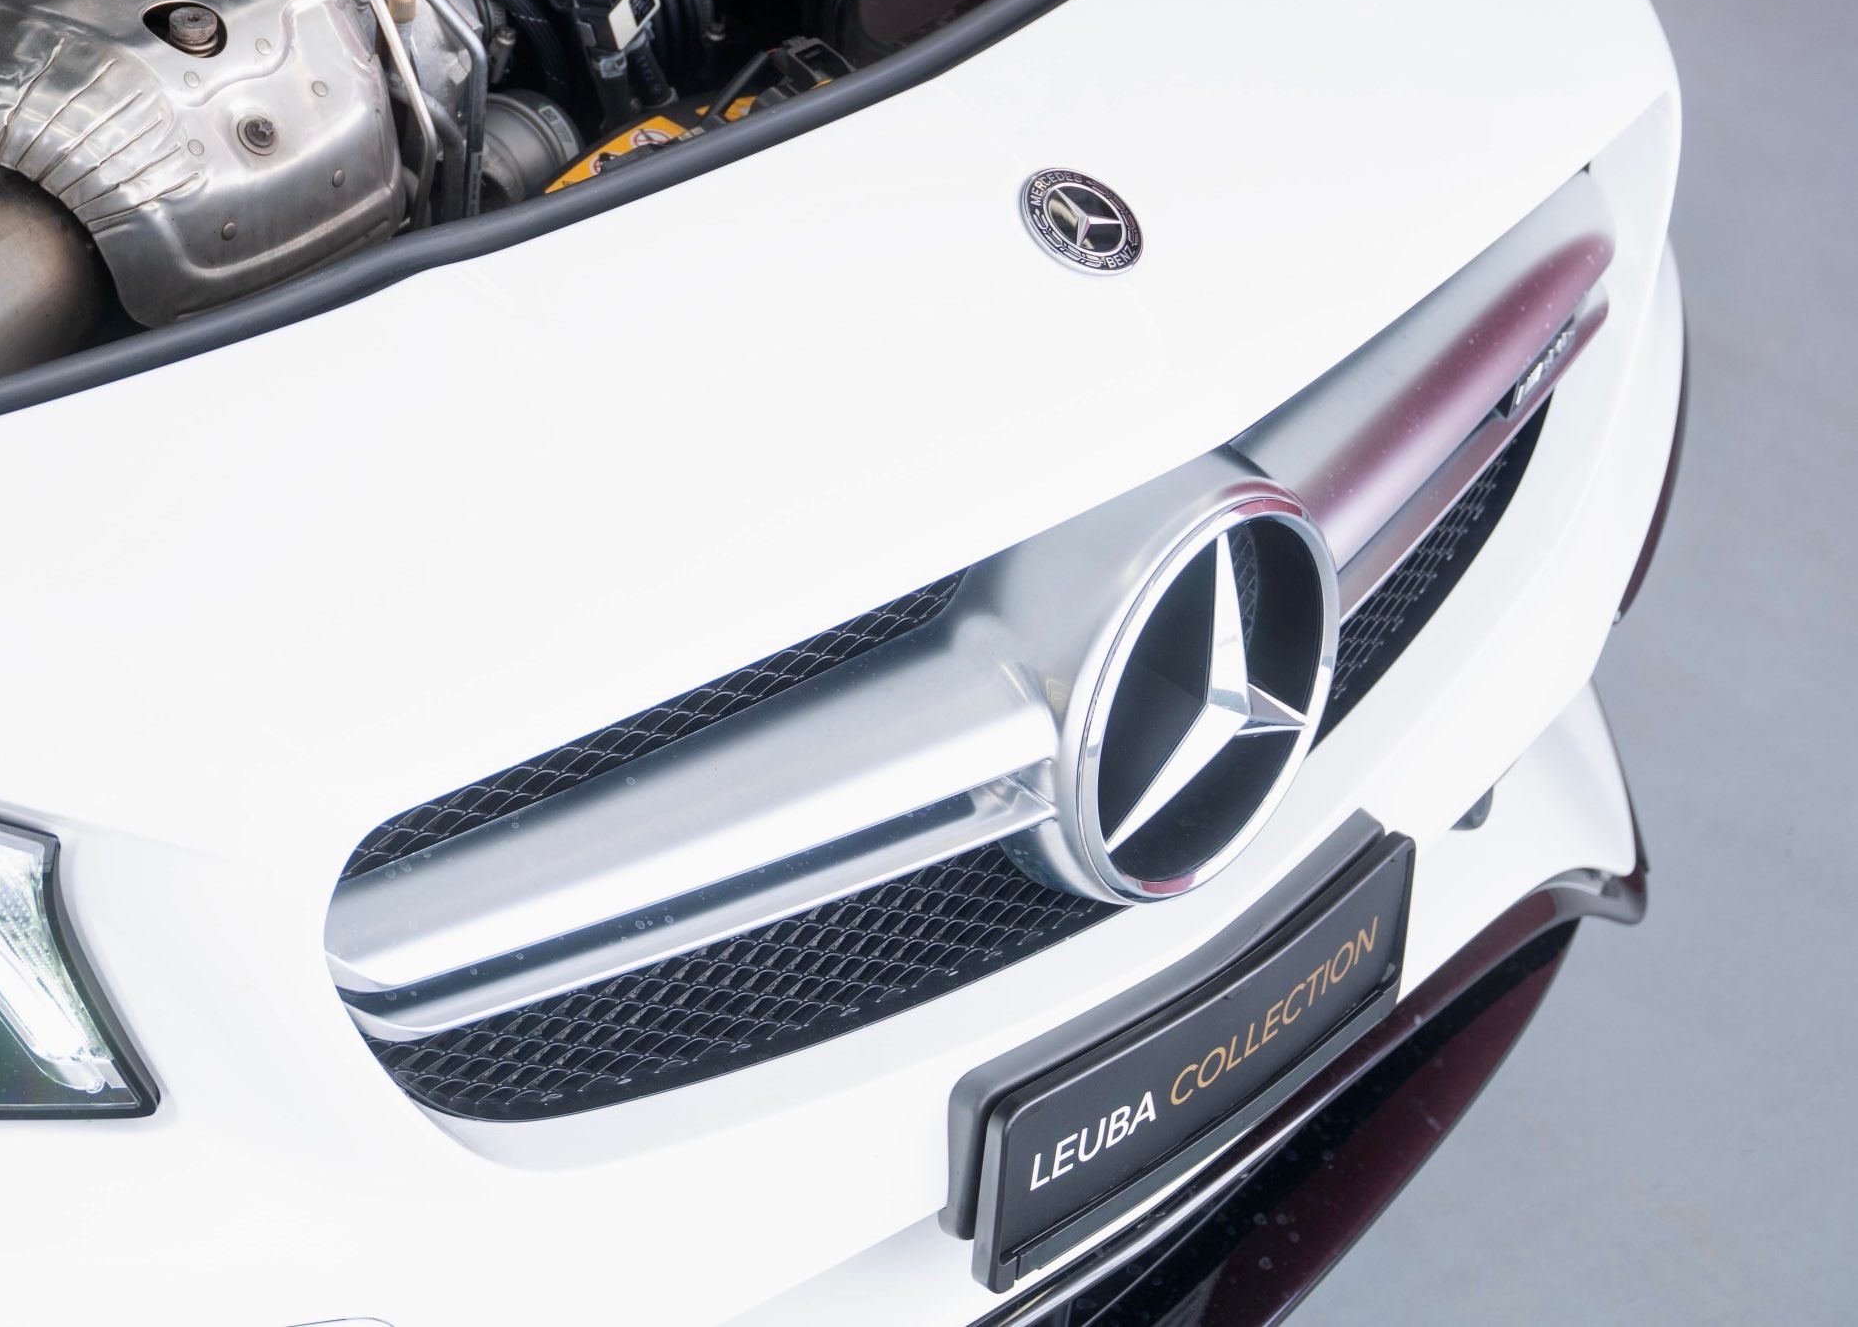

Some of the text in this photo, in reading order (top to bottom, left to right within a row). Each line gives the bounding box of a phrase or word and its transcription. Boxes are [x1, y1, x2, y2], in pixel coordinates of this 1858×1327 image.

[1030, 173, 1083, 206] MERCEDES
[1105, 244, 1137, 268] BENZ
[1029, 916, 1379, 1192] LEUBA COLLECTION
